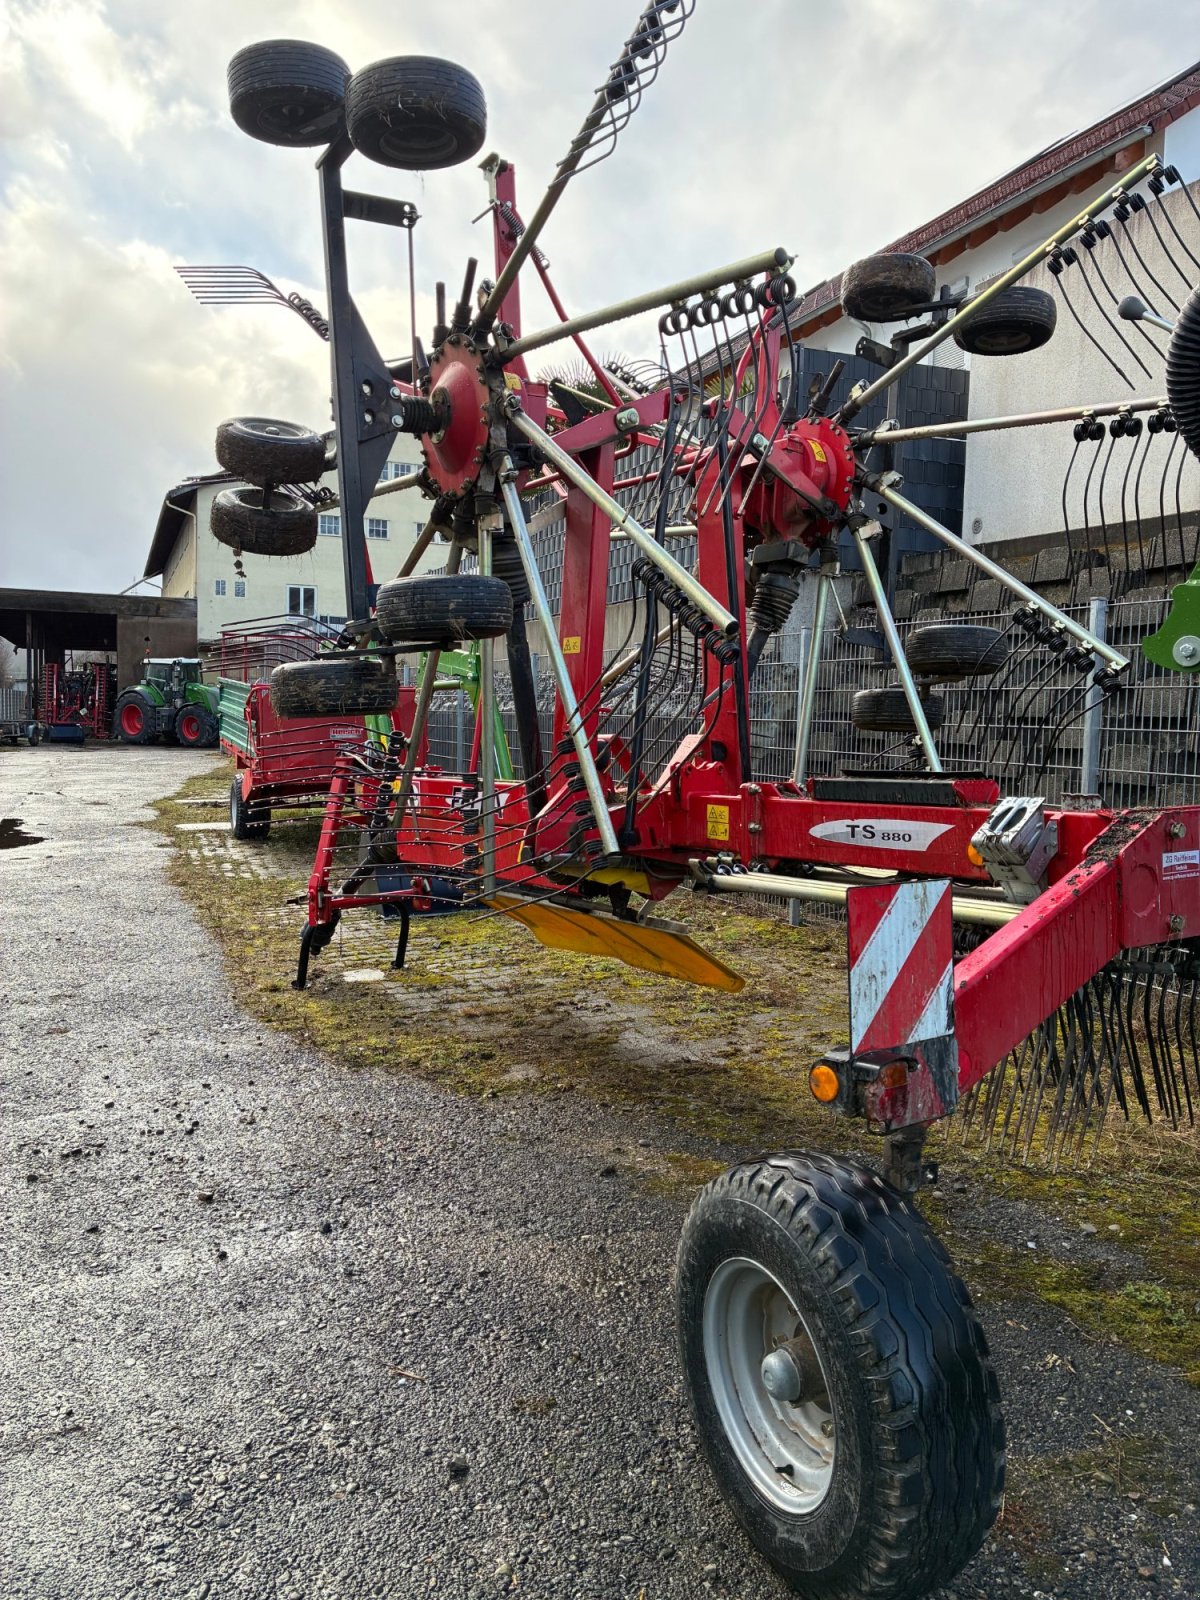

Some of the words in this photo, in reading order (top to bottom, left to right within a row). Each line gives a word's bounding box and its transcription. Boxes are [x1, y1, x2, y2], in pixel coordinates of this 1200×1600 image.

[846, 824, 876, 840] TS
[881, 832, 912, 842] 880
[1166, 856, 1173, 864] ZG
